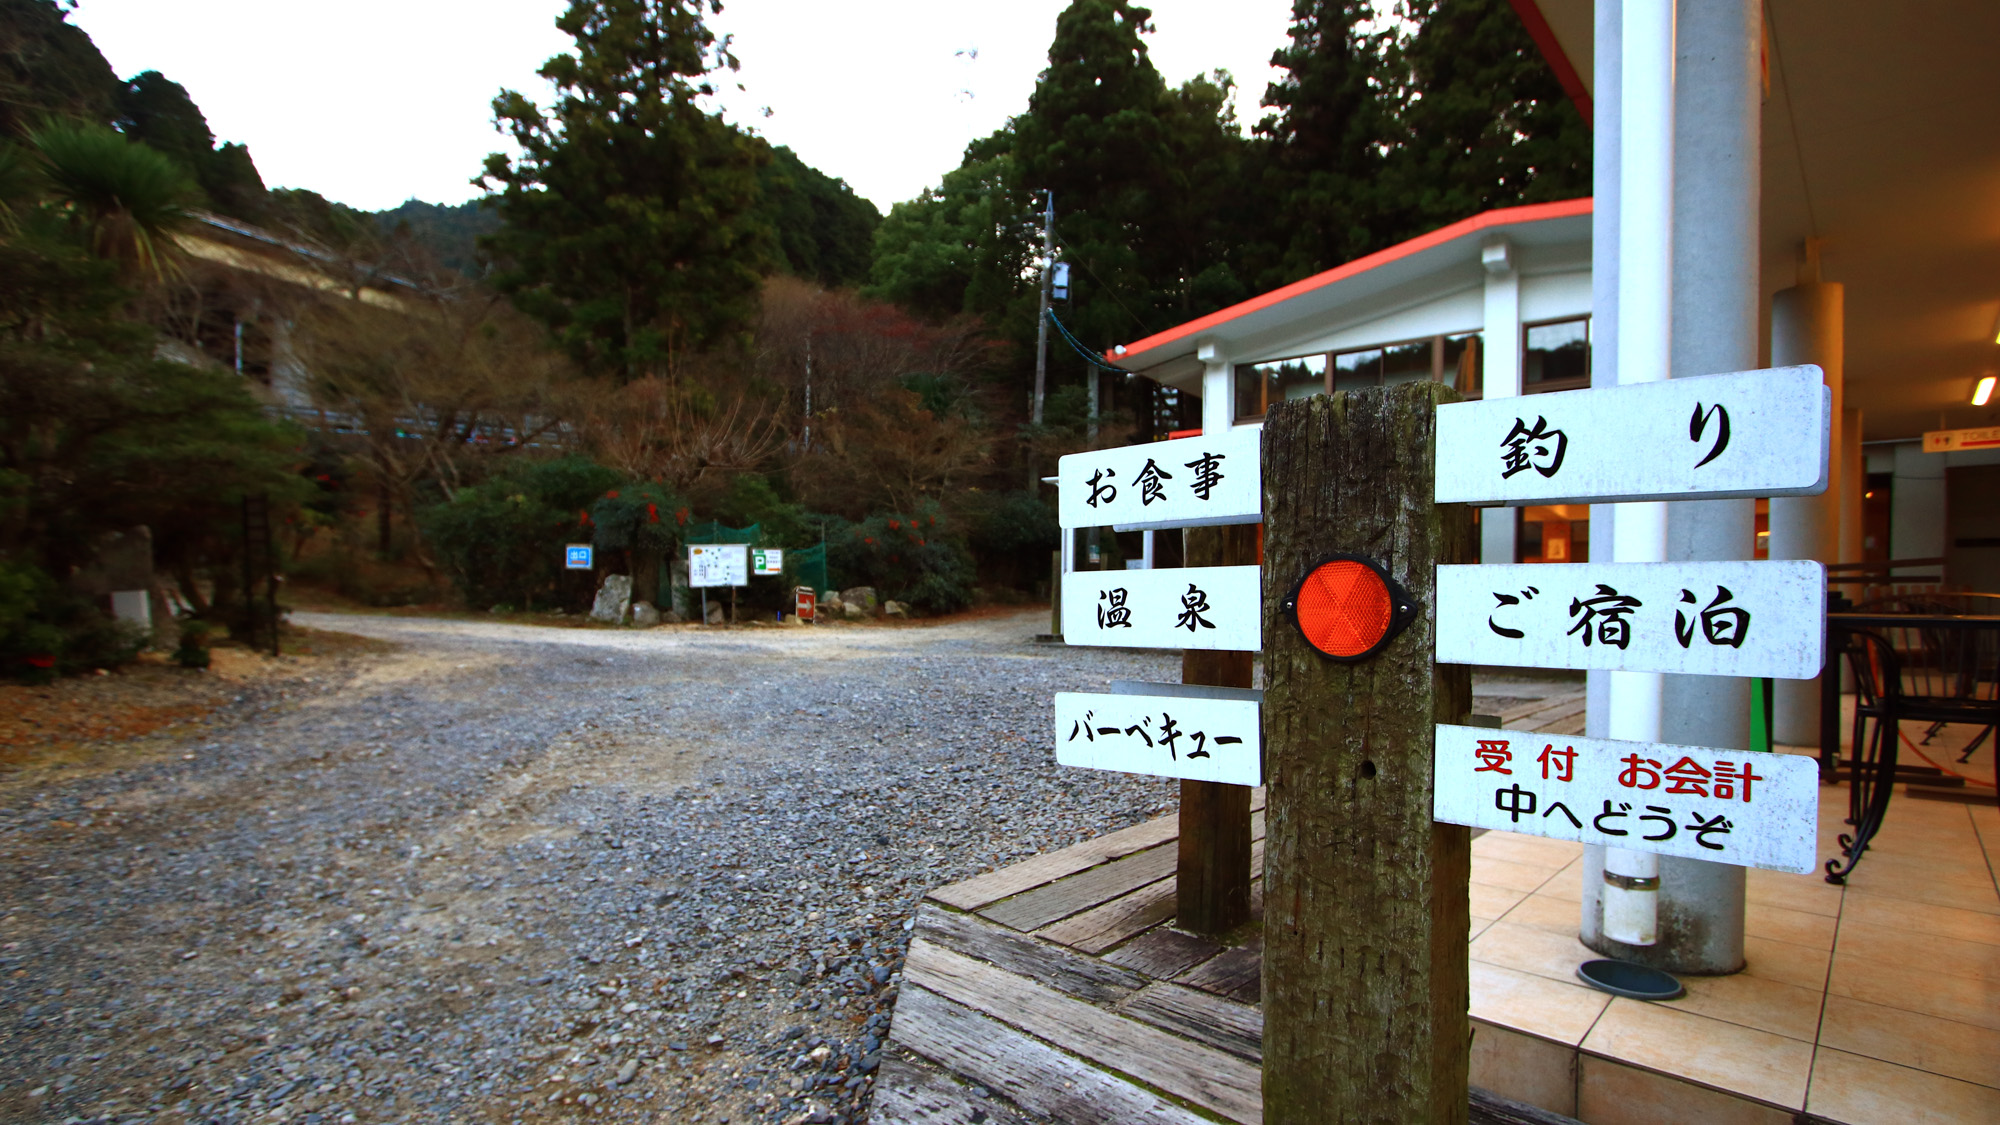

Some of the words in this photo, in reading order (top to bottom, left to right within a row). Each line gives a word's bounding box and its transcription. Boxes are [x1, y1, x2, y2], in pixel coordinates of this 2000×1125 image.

[1500, 401, 1731, 480] 釣り
[1085, 452, 1226, 509] お食事
[755, 556, 765, 569] P
[1097, 584, 1217, 633] 温泉
[1488, 585, 1751, 650] ご宿泊
[1068, 711, 1243, 761] バーベキュー
[1474, 739, 1579, 782] 受付
[1618, 753, 1763, 803] お会計
[1495, 783, 1734, 852] 中へどうぞ
